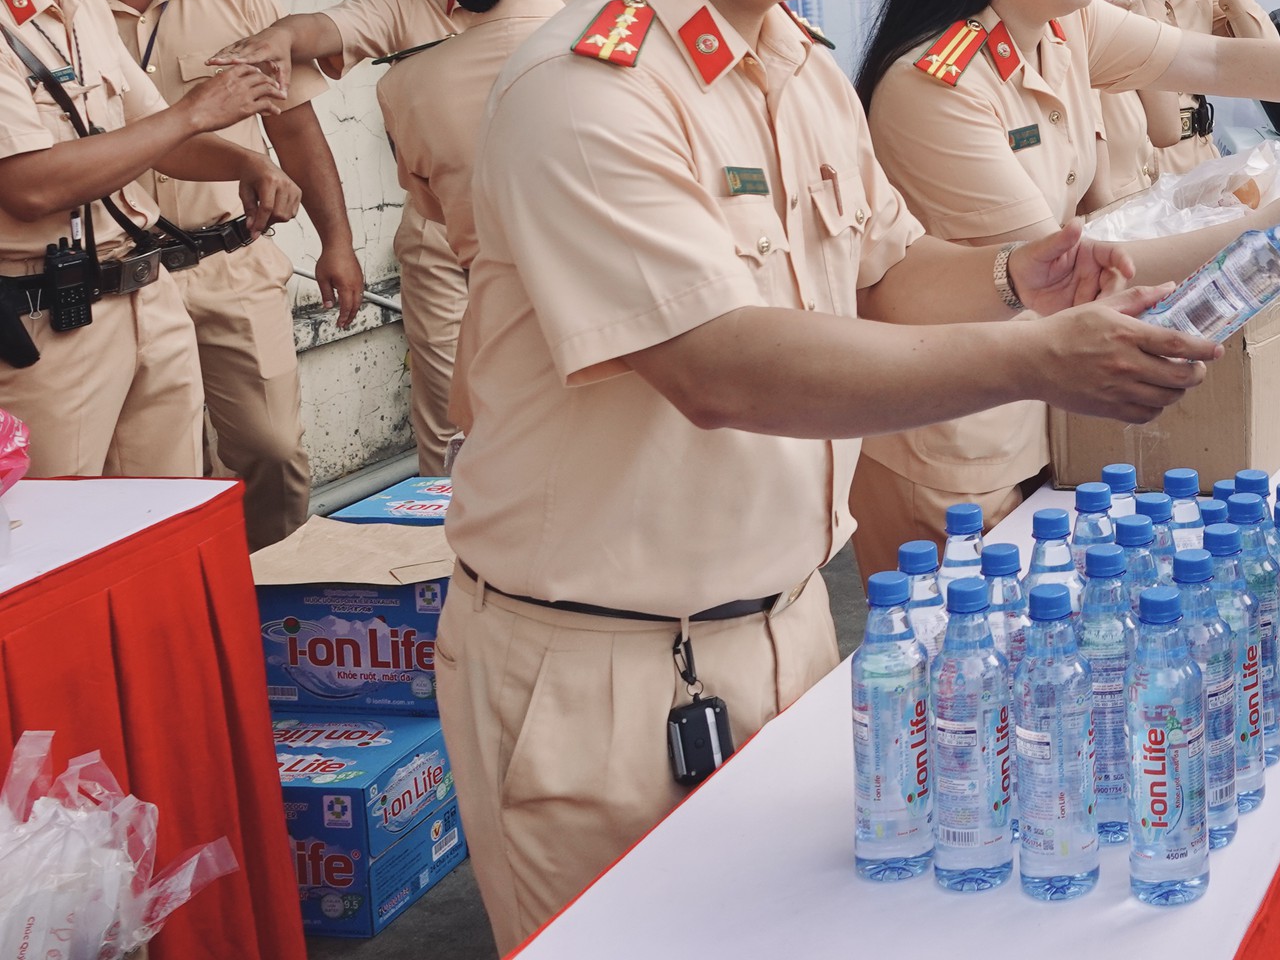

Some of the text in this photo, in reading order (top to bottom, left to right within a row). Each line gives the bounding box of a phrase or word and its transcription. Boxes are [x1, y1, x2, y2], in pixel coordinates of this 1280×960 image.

[284, 618, 435, 670] i-on Life
[1241, 645, 1260, 742] i-on Life
[908, 699, 928, 803] i-on Life
[996, 705, 1010, 756] Life
[1144, 728, 1167, 776] Life
[283, 759, 346, 773] Life
[381, 790, 413, 825] i-on
[414, 765, 443, 799] Life
[1142, 782, 1168, 827] i-on
[296, 841, 355, 888] ife
[24, 916, 35, 940] Chúc
